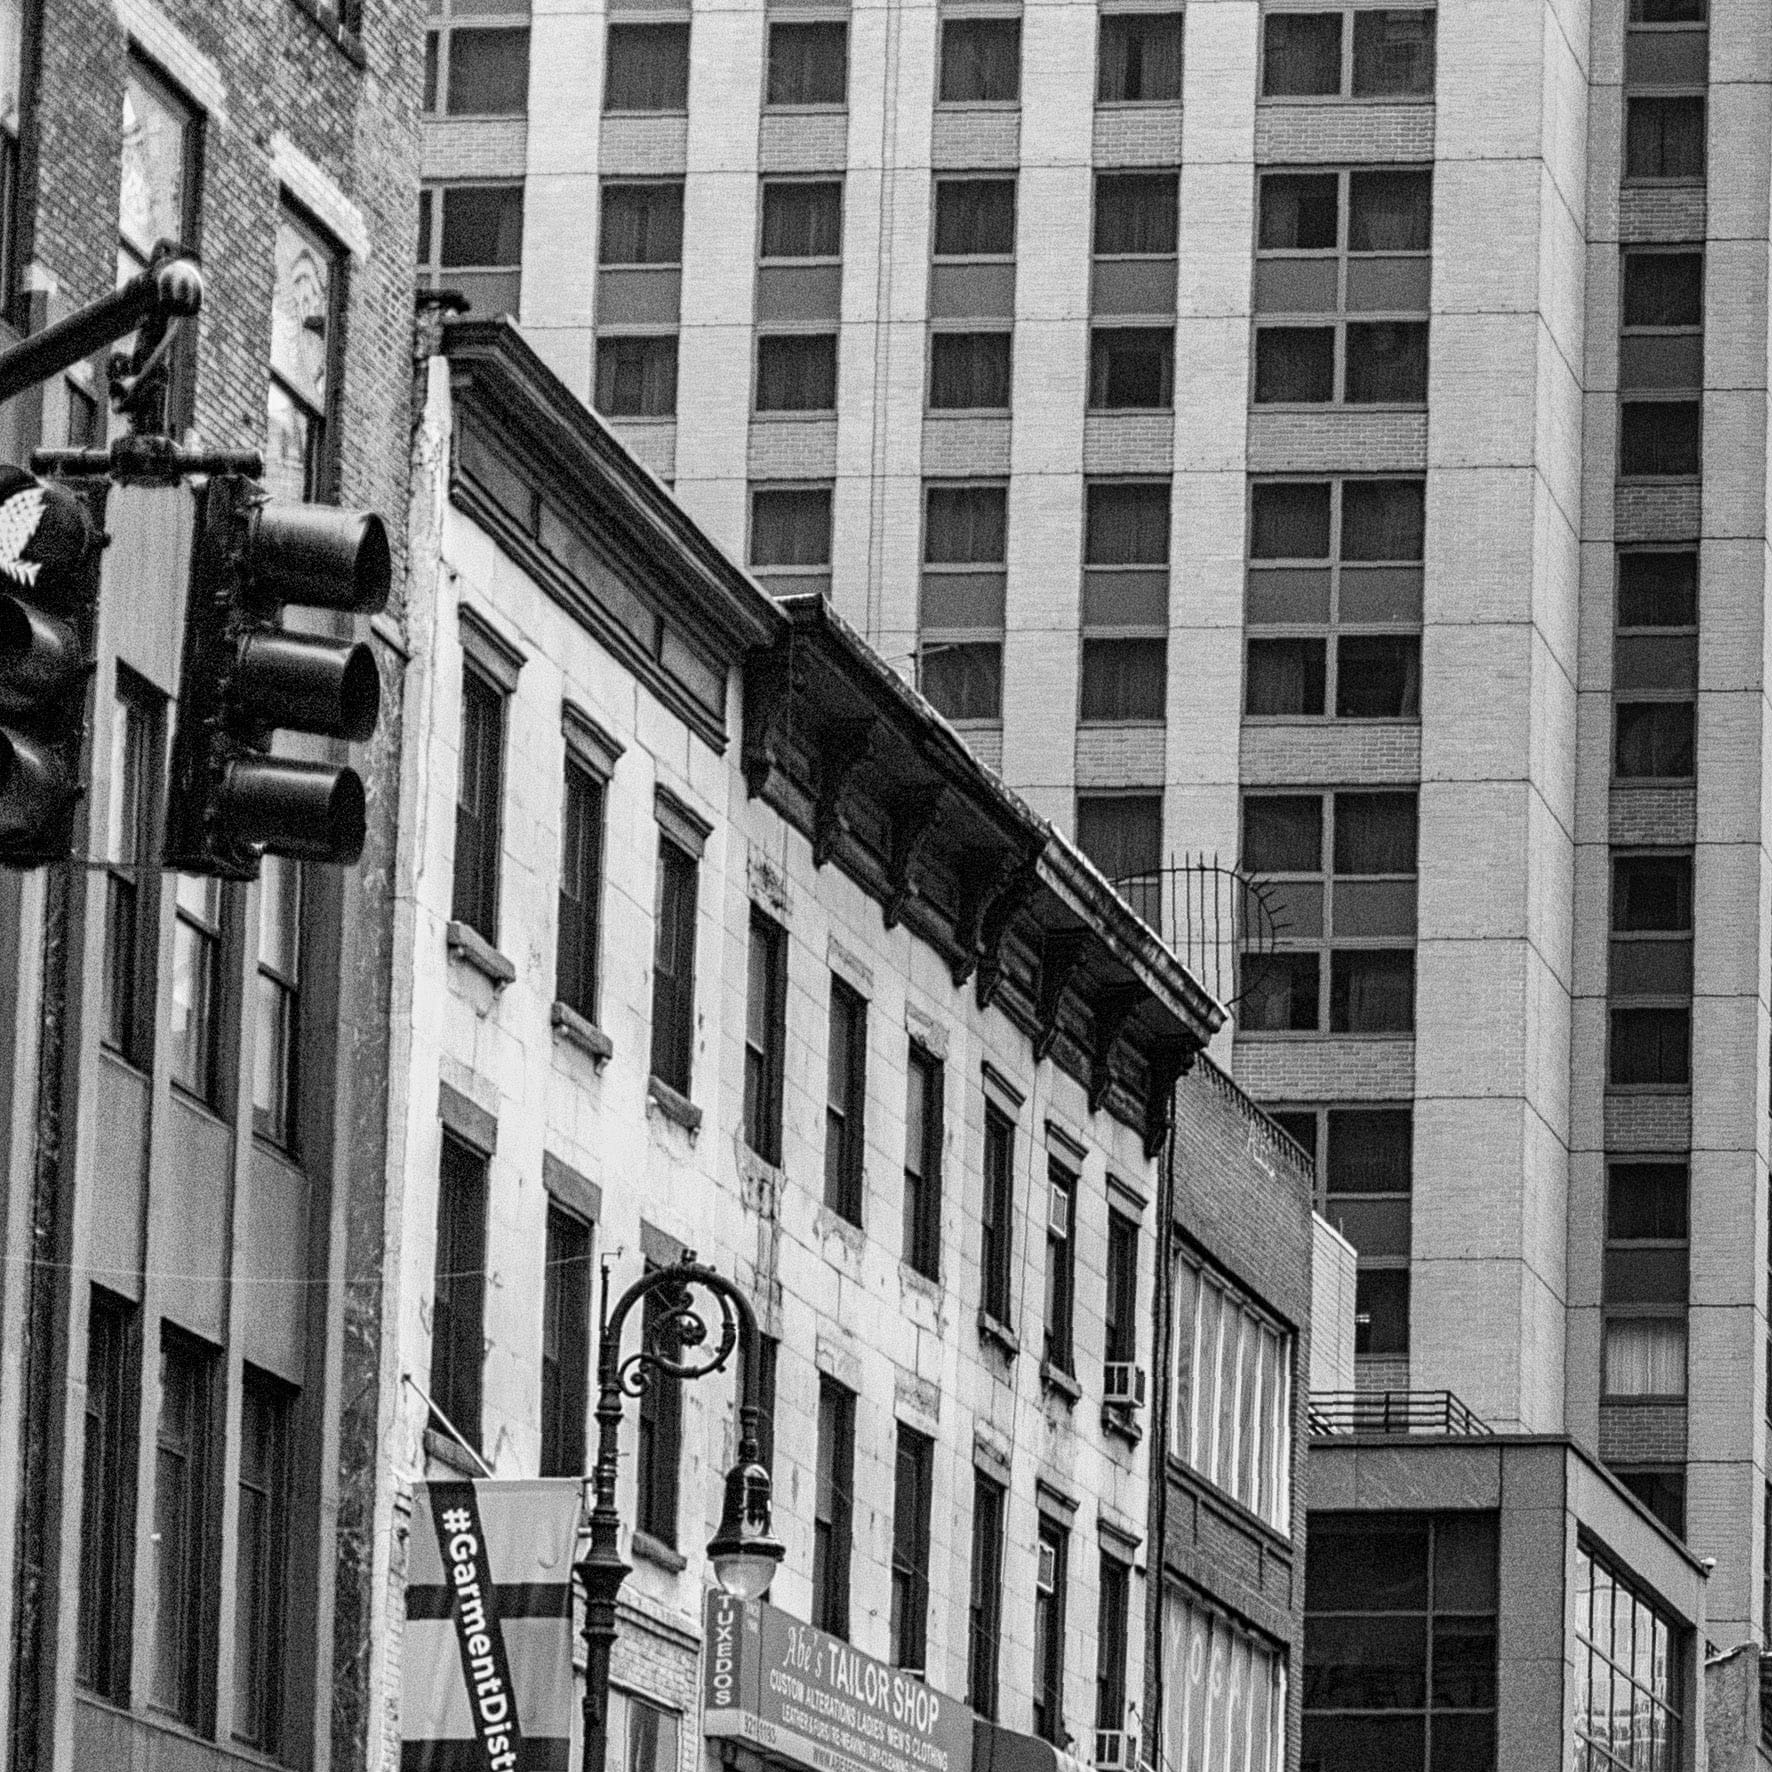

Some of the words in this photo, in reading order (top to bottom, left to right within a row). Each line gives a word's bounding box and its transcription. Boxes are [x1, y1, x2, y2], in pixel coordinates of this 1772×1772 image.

[714, 1594, 734, 1705] TUXEDOS
[770, 1668, 804, 1703] CUSTOM
[805, 1686, 856, 1728] ALTERATIONS
[782, 1625, 823, 1679] Abe's
[828, 1642, 889, 1713] TAILOR
[892, 1676, 939, 1735] SHOP
